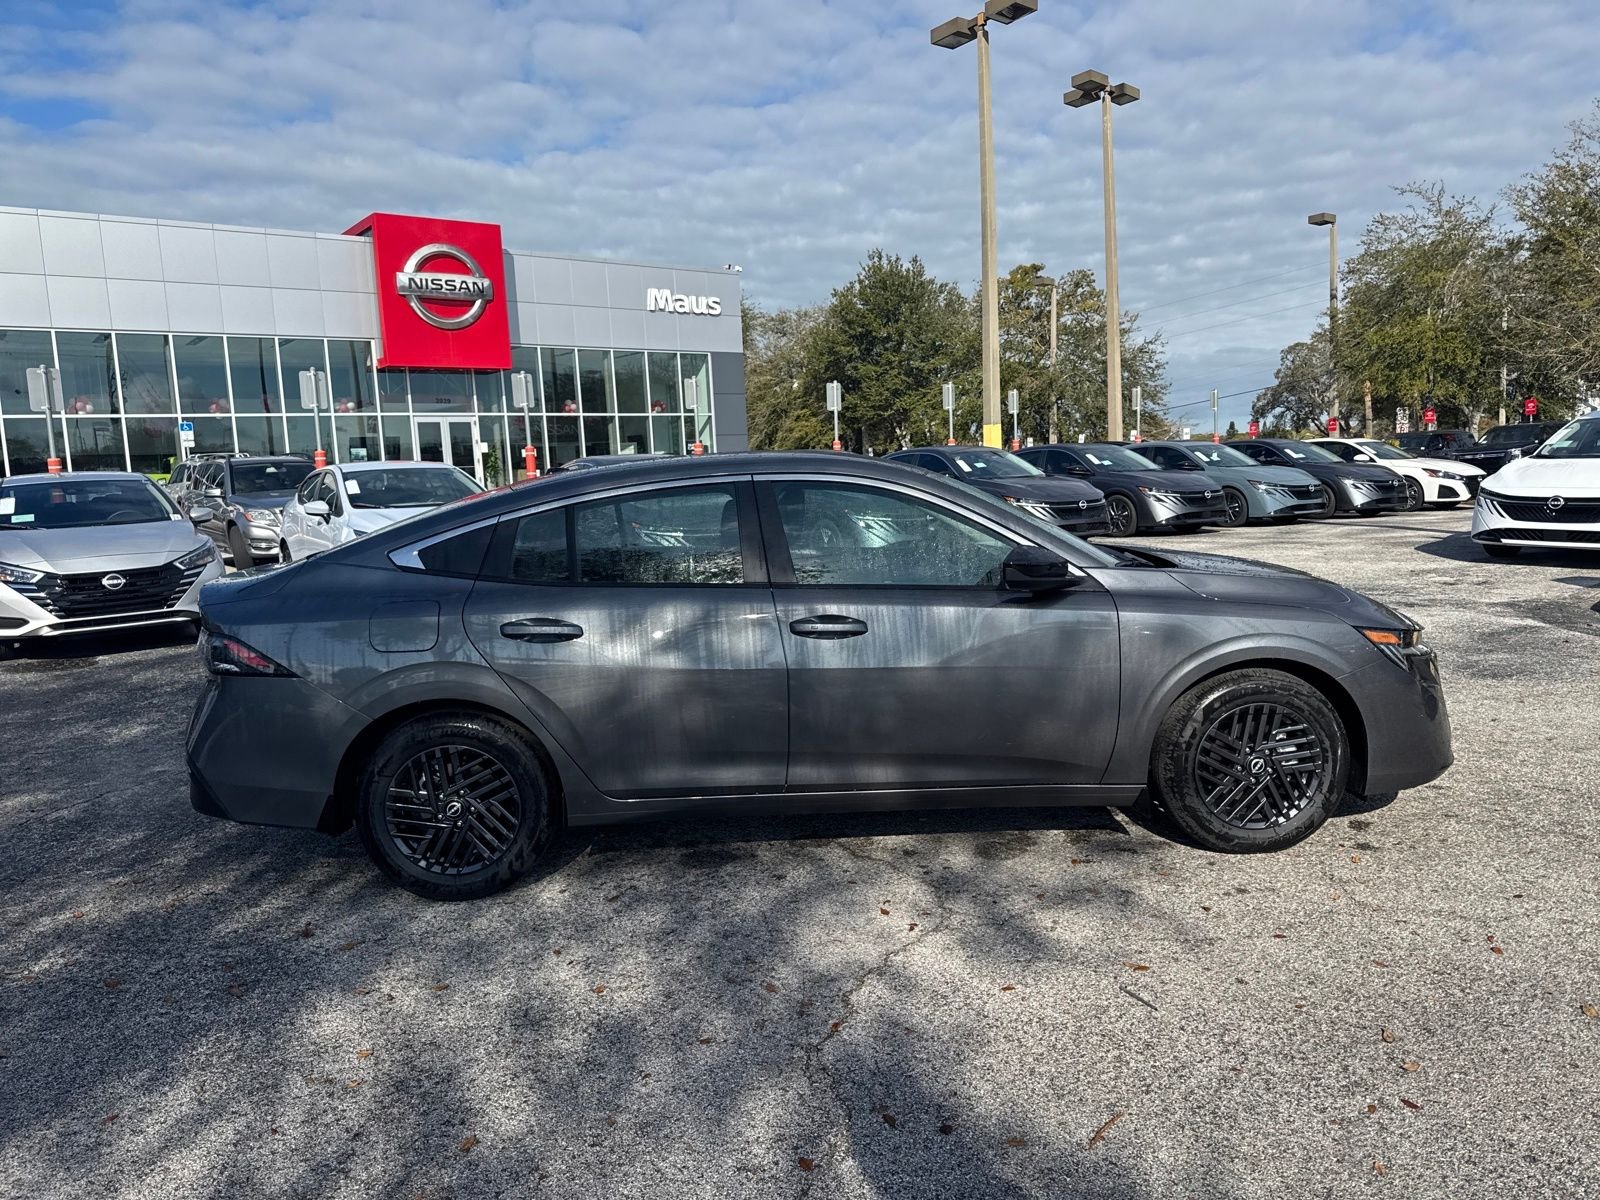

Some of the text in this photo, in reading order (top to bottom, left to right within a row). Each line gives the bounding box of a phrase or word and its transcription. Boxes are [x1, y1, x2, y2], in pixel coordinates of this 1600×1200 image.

[407, 277, 485, 294] NISSAN
[646, 287, 722, 316] Maus
[534, 423, 579, 435] NSSAN
